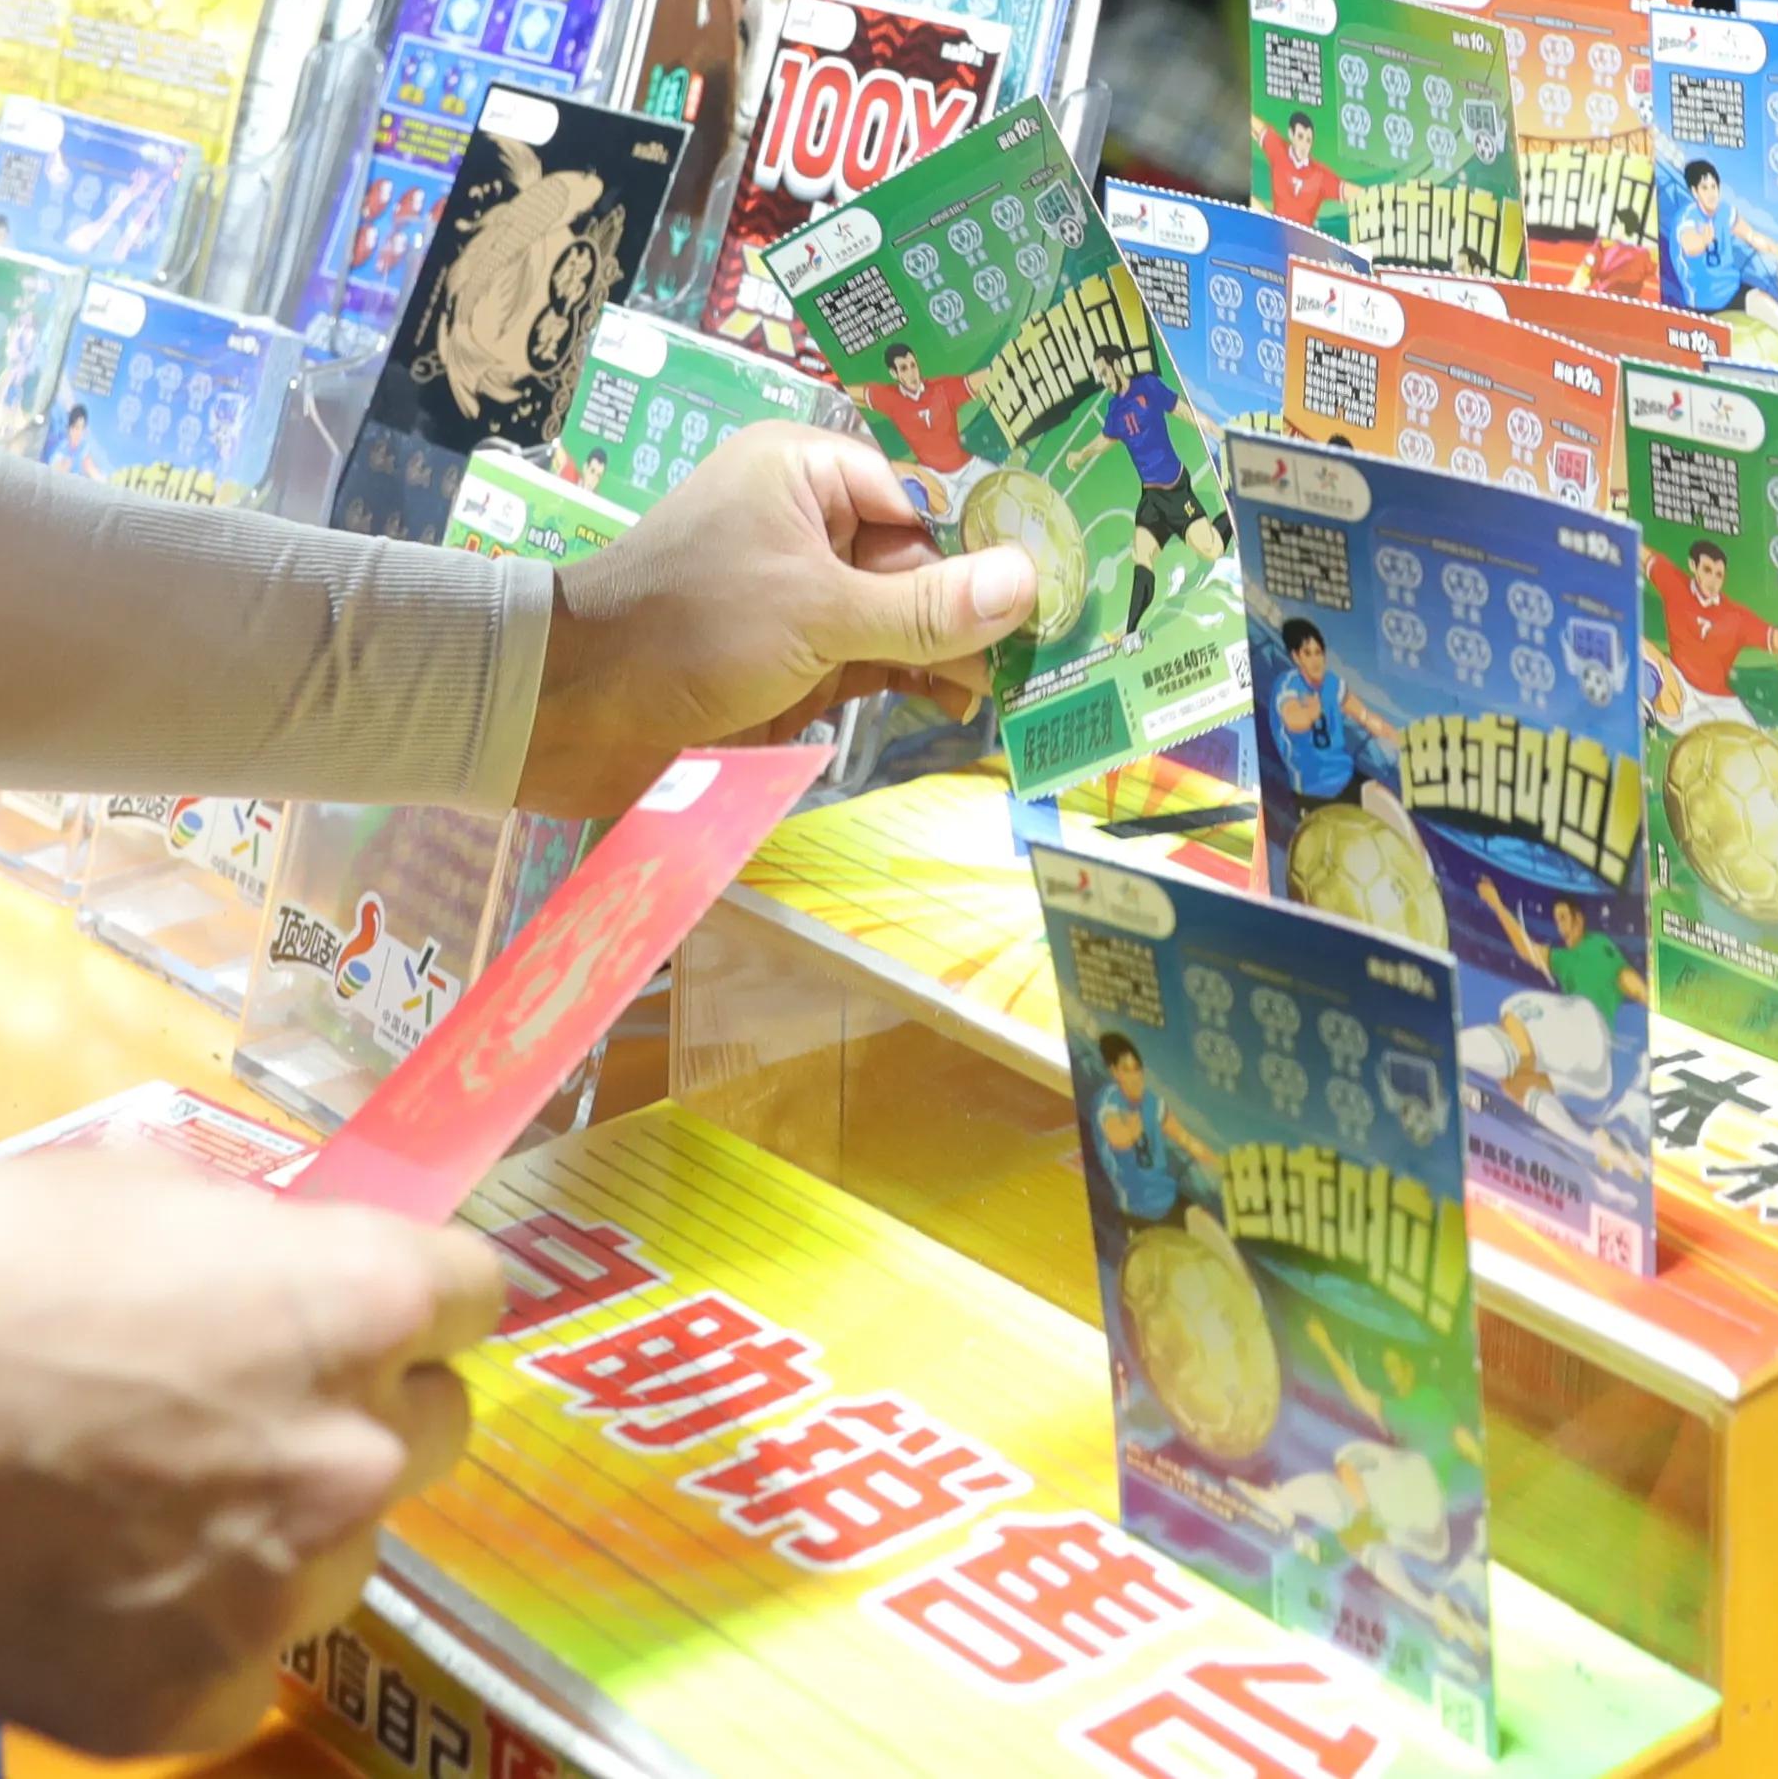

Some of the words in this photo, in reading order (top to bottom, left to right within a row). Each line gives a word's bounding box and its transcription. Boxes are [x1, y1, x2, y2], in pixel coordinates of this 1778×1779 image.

[997, 116, 1041, 152] 面值10元
[1519, 146, 1658, 246] 球啦
[979, 264, 1154, 450] 进球啦!
[1552, 358, 1603, 396] 面值10元
[918, 409, 933, 430] 7
[1696, 615, 1713, 640] 7
[1142, 641, 1220, 689] 最高奖金40万元
[1311, 719, 1331, 749] 8
[1398, 712, 1643, 884] 进球啦!
[270, 905, 340, 974] 顶呱刮
[381, 1008, 427, 1046] 中国体育
[1468, 1133, 1584, 1205] 最高奖金40万元
[1222, 1141, 1465, 1336] 进球啦!
[489, 1216, 1386, 1779] 自助销售台
